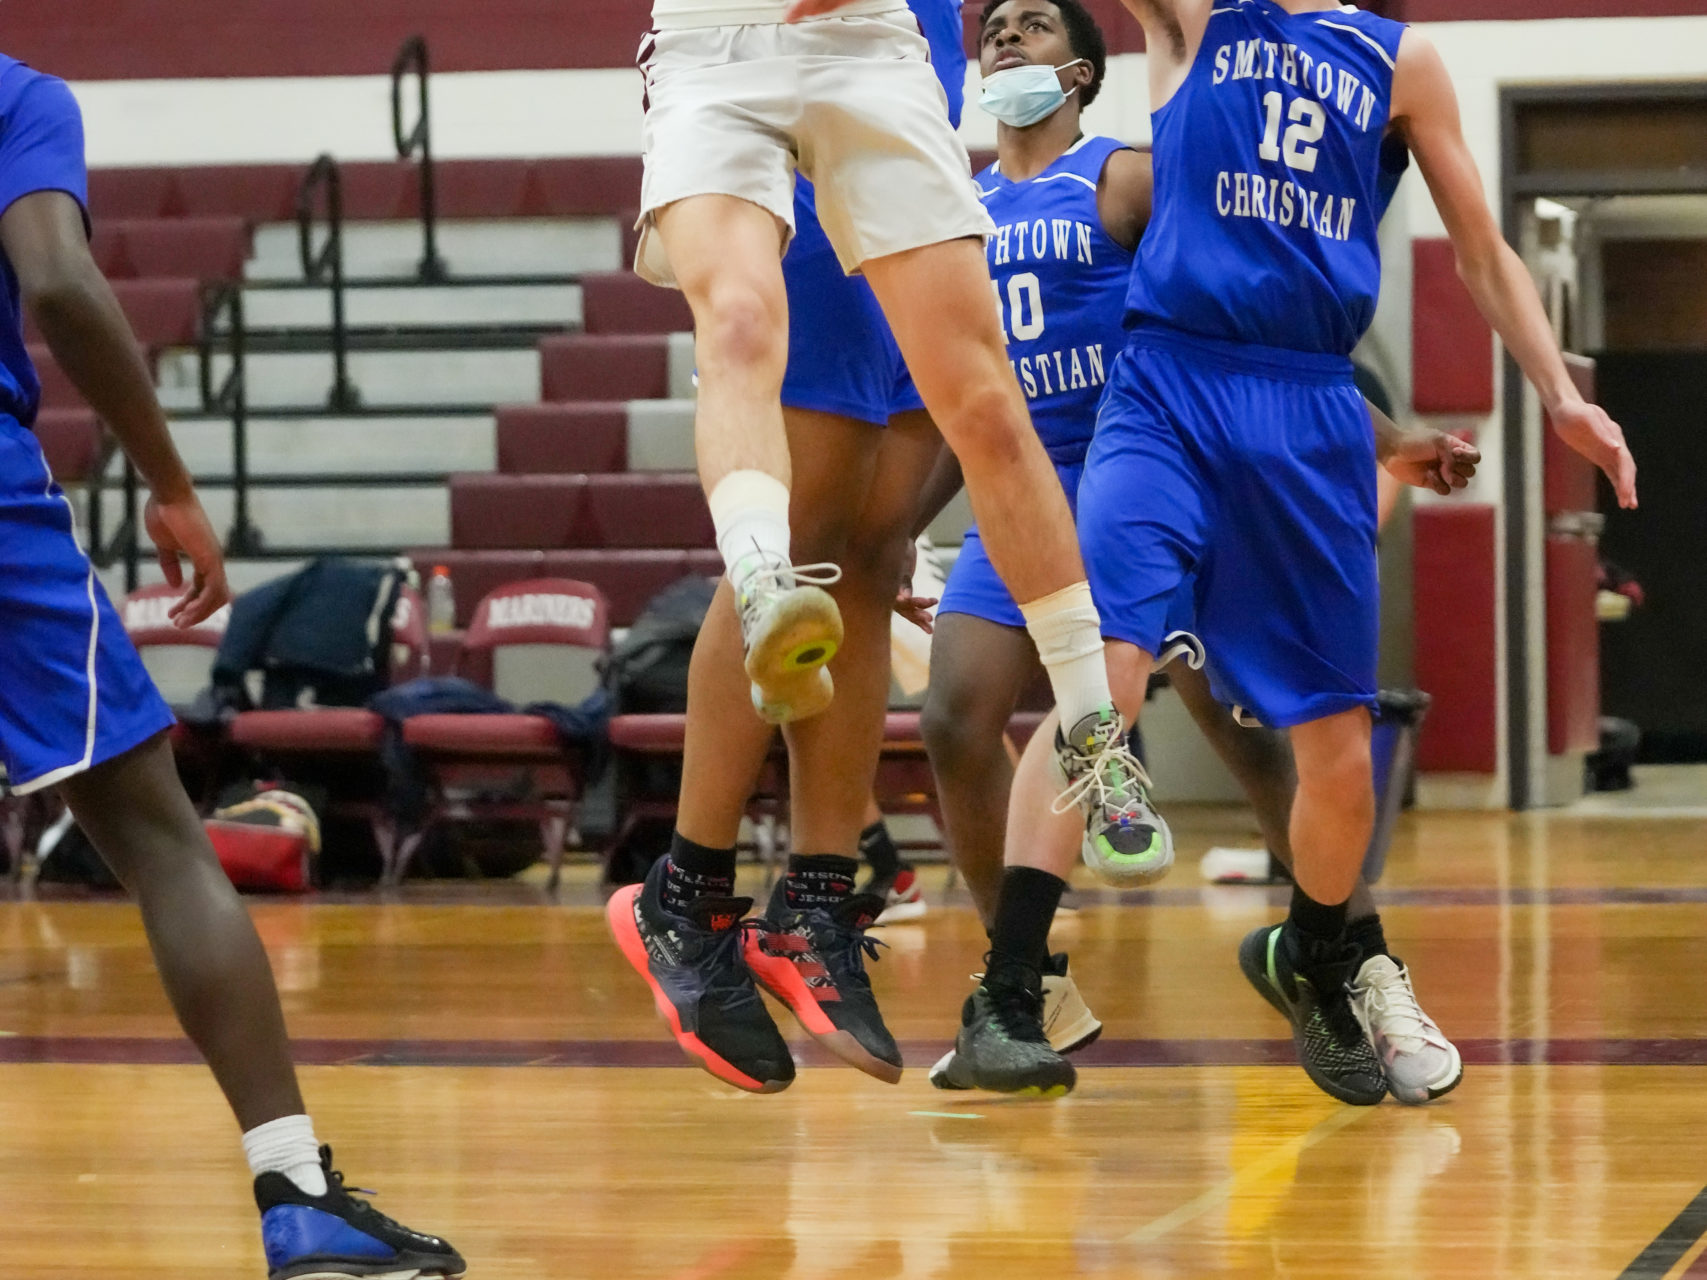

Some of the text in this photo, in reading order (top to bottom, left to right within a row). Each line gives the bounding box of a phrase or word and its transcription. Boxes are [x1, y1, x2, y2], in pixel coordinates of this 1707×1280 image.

[1212, 38, 1377, 133] SMITHTOWN
[1258, 90, 1327, 173] 12
[1215, 170, 1357, 242] CHRISTIAN
[487, 592, 597, 629] MARINERS
